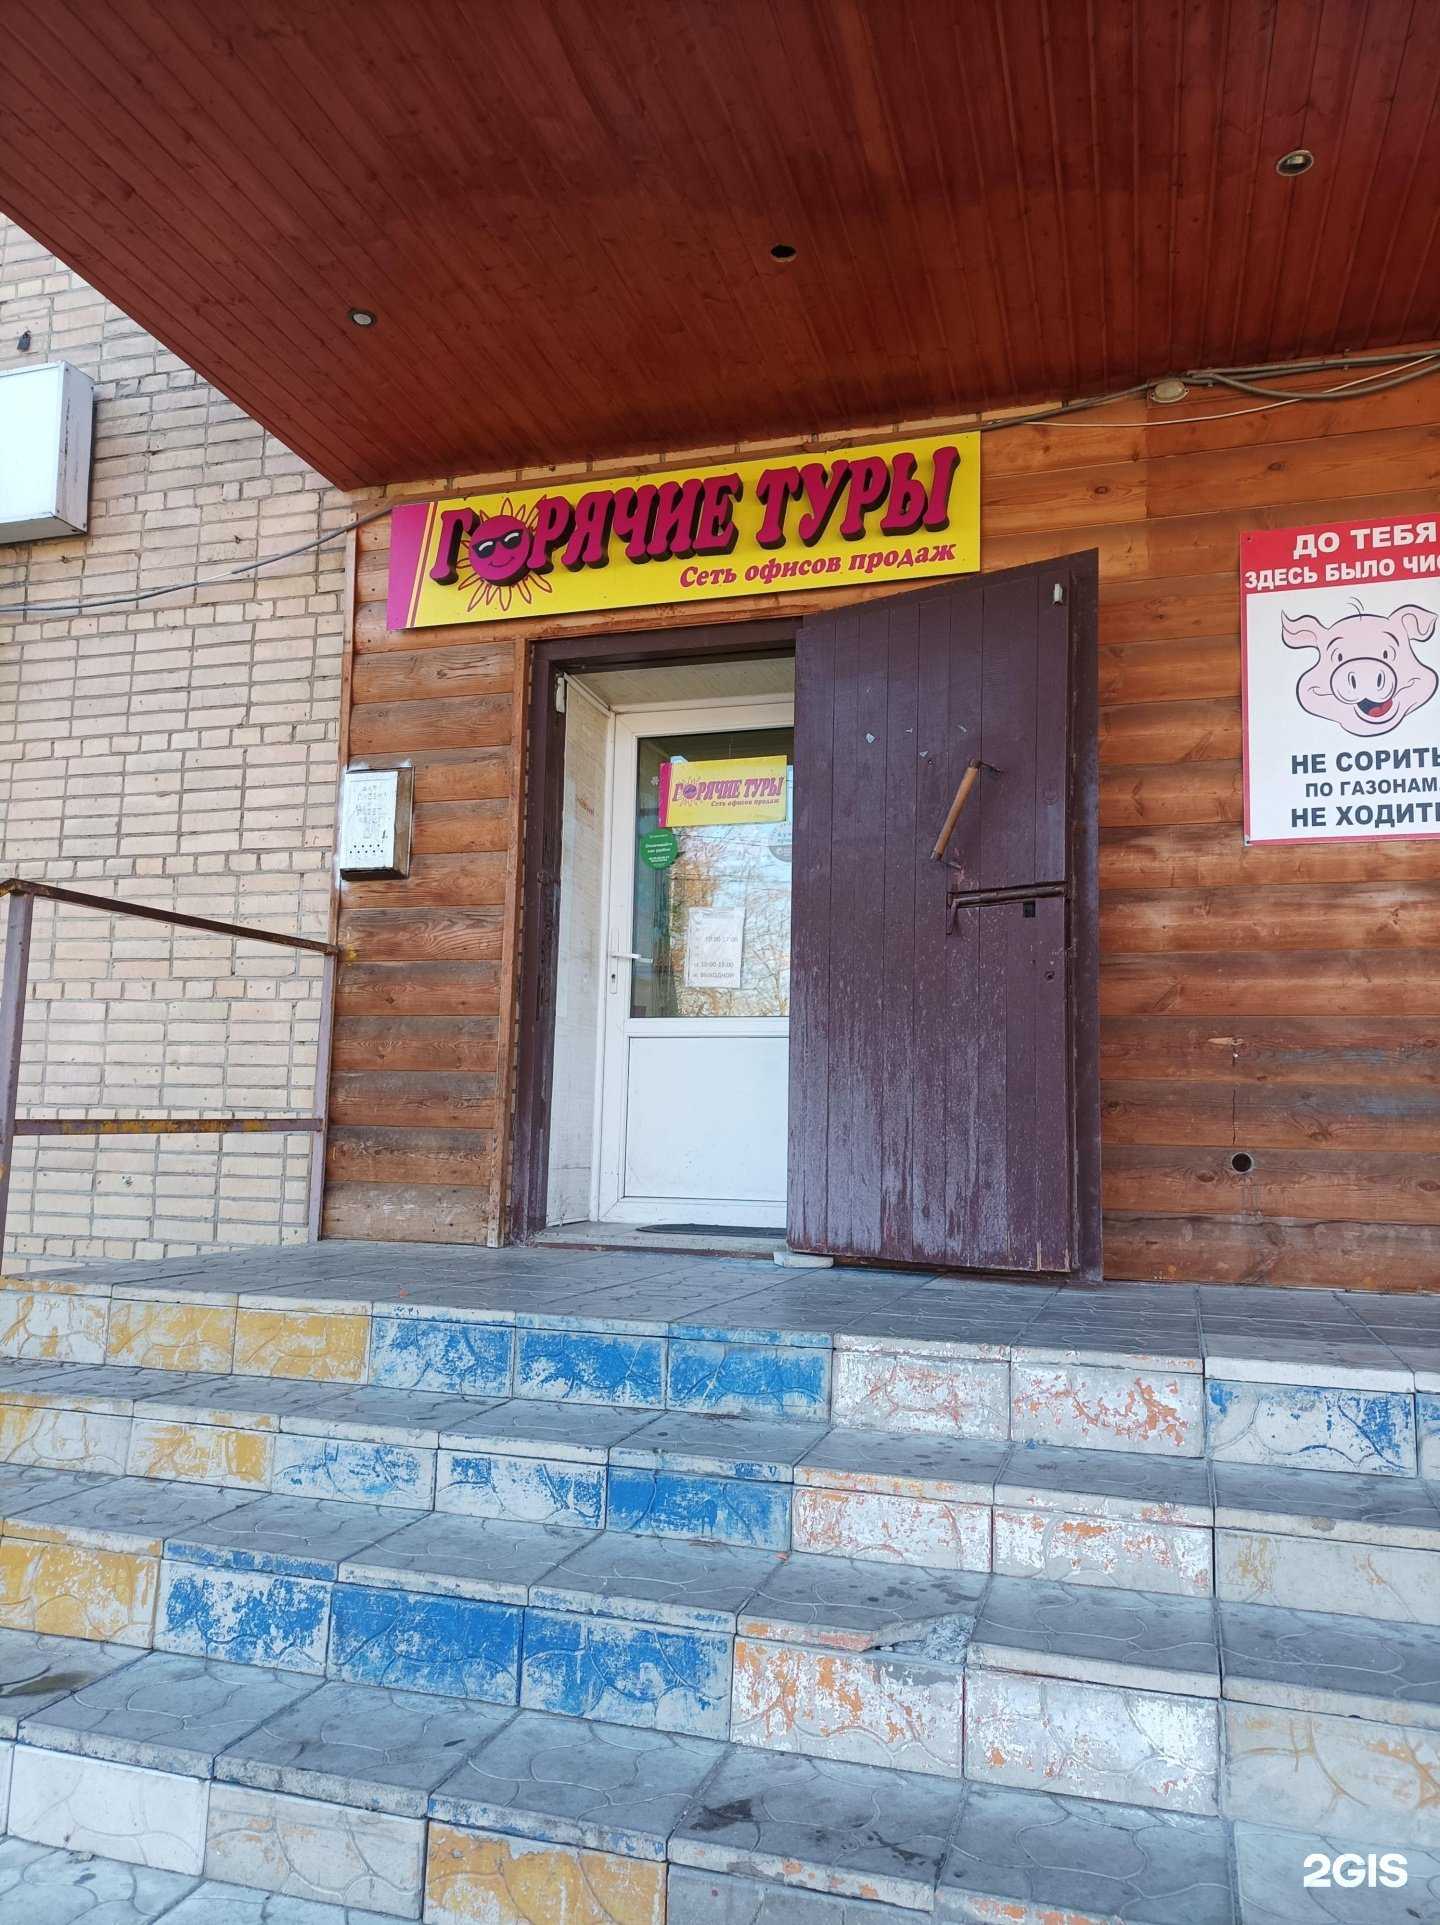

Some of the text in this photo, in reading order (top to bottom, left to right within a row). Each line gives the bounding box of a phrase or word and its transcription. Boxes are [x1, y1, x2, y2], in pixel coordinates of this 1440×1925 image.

[428, 446, 961, 587] ГОРЯЧИЕ ТУРЫ
[1293, 522, 1437, 559] ДО ТЕБЯ
[680, 544, 957, 588] Сеть офисов продаж
[1244, 554, 1440, 590] ЗДЕСЬ БЫЛО ЧИ
[1291, 753, 1327, 775] НЕ
[1305, 782, 1333, 797] ПО
[1291, 802, 1440, 829] НЕ ХОДИТ
